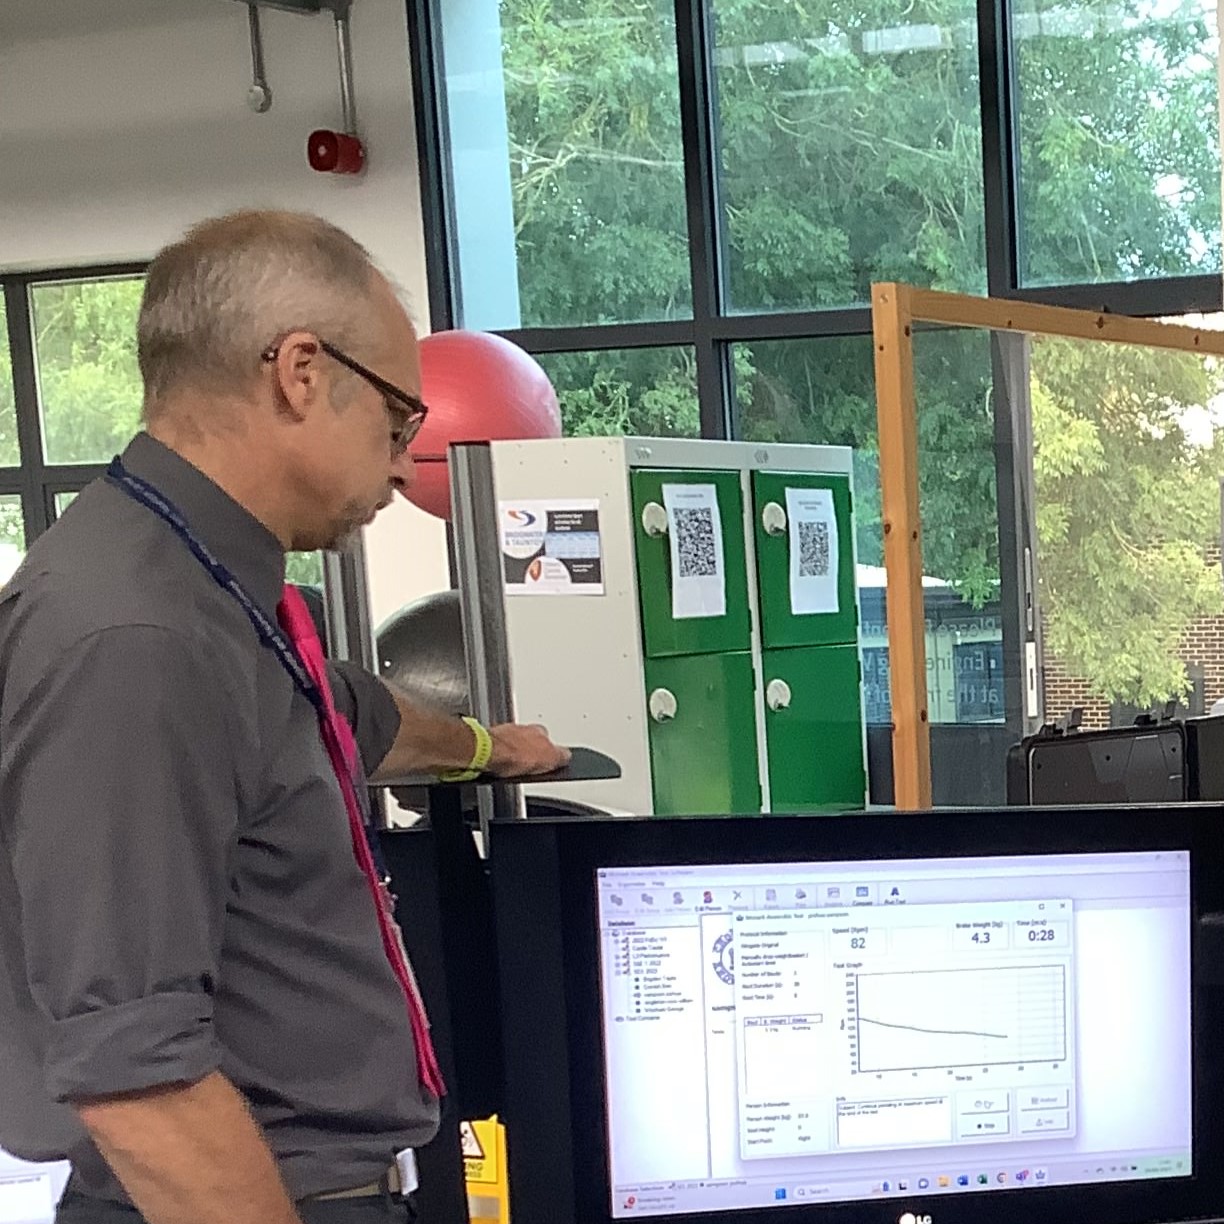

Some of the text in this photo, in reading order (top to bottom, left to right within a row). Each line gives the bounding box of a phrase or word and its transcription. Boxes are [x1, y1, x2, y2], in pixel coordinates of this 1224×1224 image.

[971, 932, 991, 944] 4.3
[1028, 930, 1055, 942] 0:28
[850, 938, 866, 949] 82
